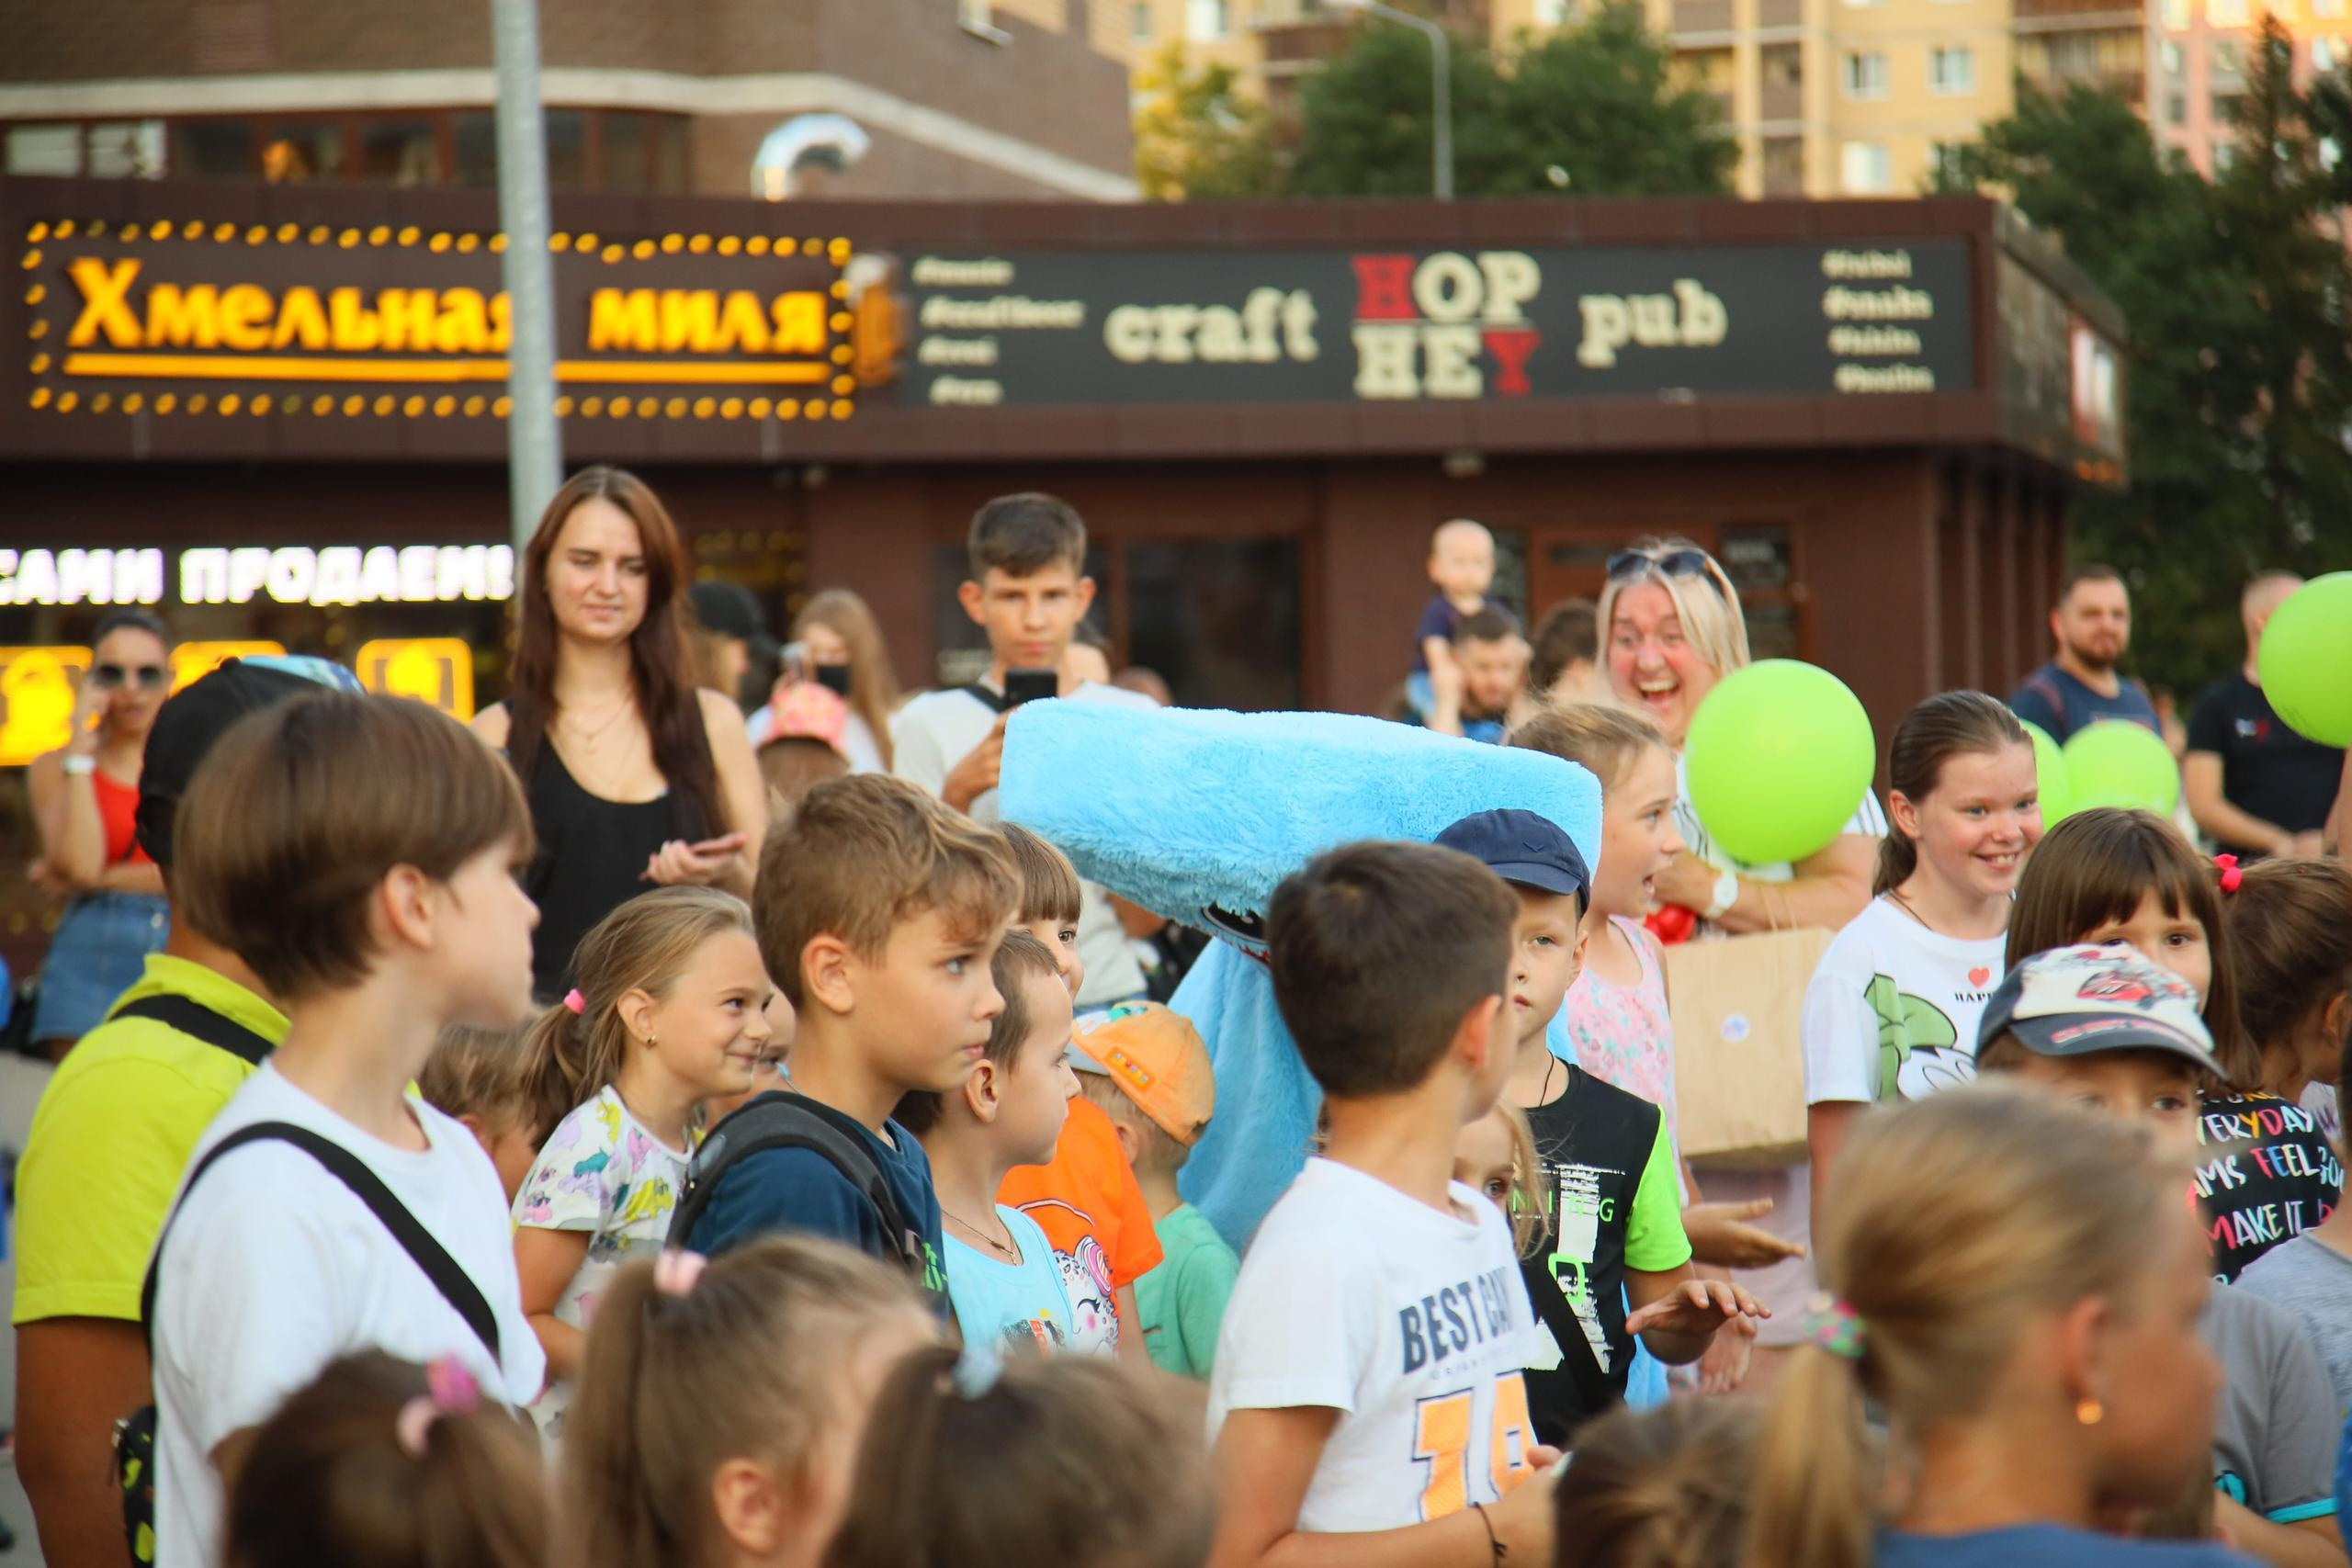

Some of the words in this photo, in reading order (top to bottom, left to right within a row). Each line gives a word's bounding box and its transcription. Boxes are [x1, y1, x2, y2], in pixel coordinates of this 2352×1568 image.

[588, 288, 828, 354] миля
[1351, 251, 1542, 323] HOP
[1577, 278, 1728, 368] pub
[1103, 287, 1320, 364] craft
[1351, 324, 1544, 400] HEY
[2249, 1144, 2321, 1179] FEEL
[2202, 1203, 2284, 1257] MAKE
[2284, 1200, 2303, 1235] IT
[1399, 1281, 1483, 1374] BEST
